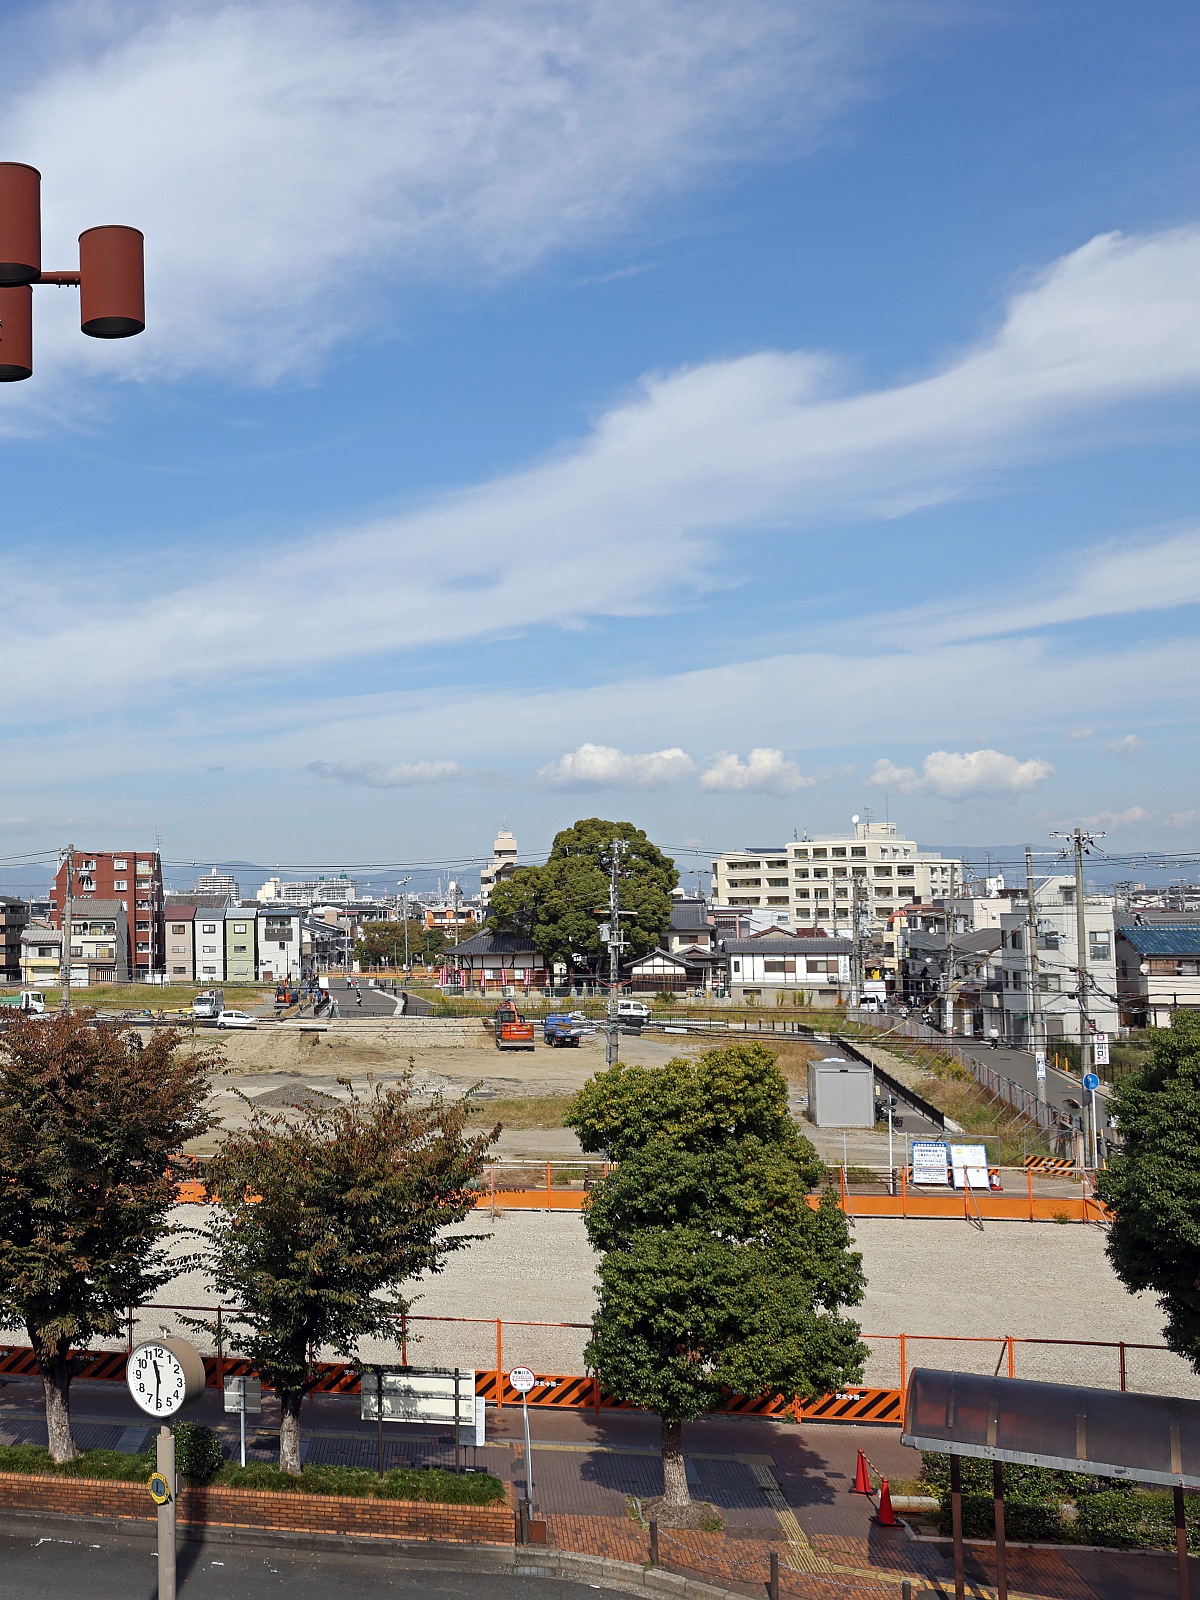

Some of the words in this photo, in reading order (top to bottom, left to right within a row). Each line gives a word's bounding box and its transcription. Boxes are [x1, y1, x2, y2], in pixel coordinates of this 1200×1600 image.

[144, 1350, 152, 1360] 11
[153, 1347, 164, 1358] 12
[137, 1358, 147, 1369] 10
[167, 1354, 172, 1364] 1
[135, 1369, 142, 1379] 9
[173, 1364, 180, 1374] 2
[138, 1382, 145, 1392] 8
[176, 1377, 183, 1388] 3
[146, 1393, 153, 1403] 7
[173, 1389, 179, 1399] 4
[166, 1396, 172, 1407] 5
